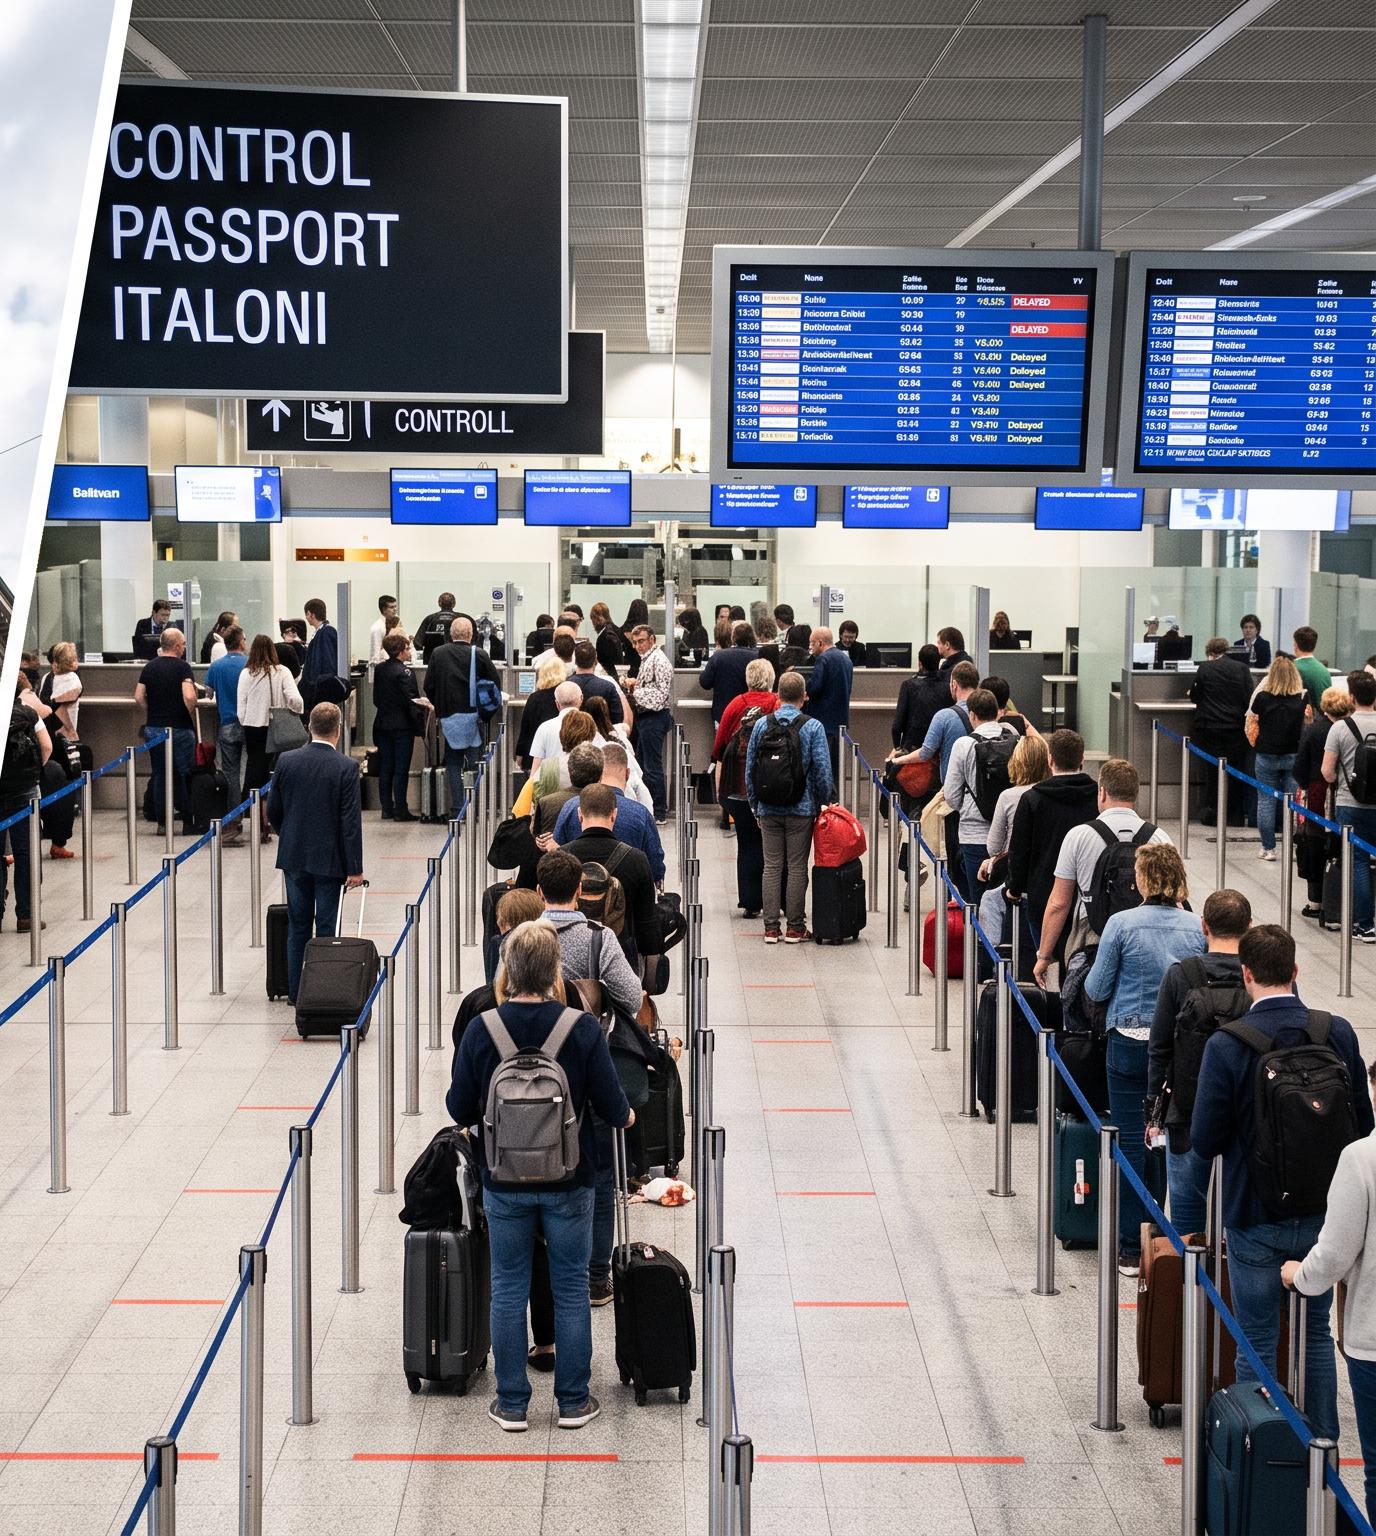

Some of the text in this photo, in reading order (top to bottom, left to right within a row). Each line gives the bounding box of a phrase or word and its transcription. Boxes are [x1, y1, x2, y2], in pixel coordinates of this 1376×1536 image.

[109, 122, 371, 187] CONTROL
[112, 204, 399, 267] PASSPORT
[114, 286, 326, 345] ITALONI
[1013, 298, 1050, 306] DELAYED
[1011, 326, 1049, 334] DELAYED
[394, 409, 514, 434] CONTROLL
